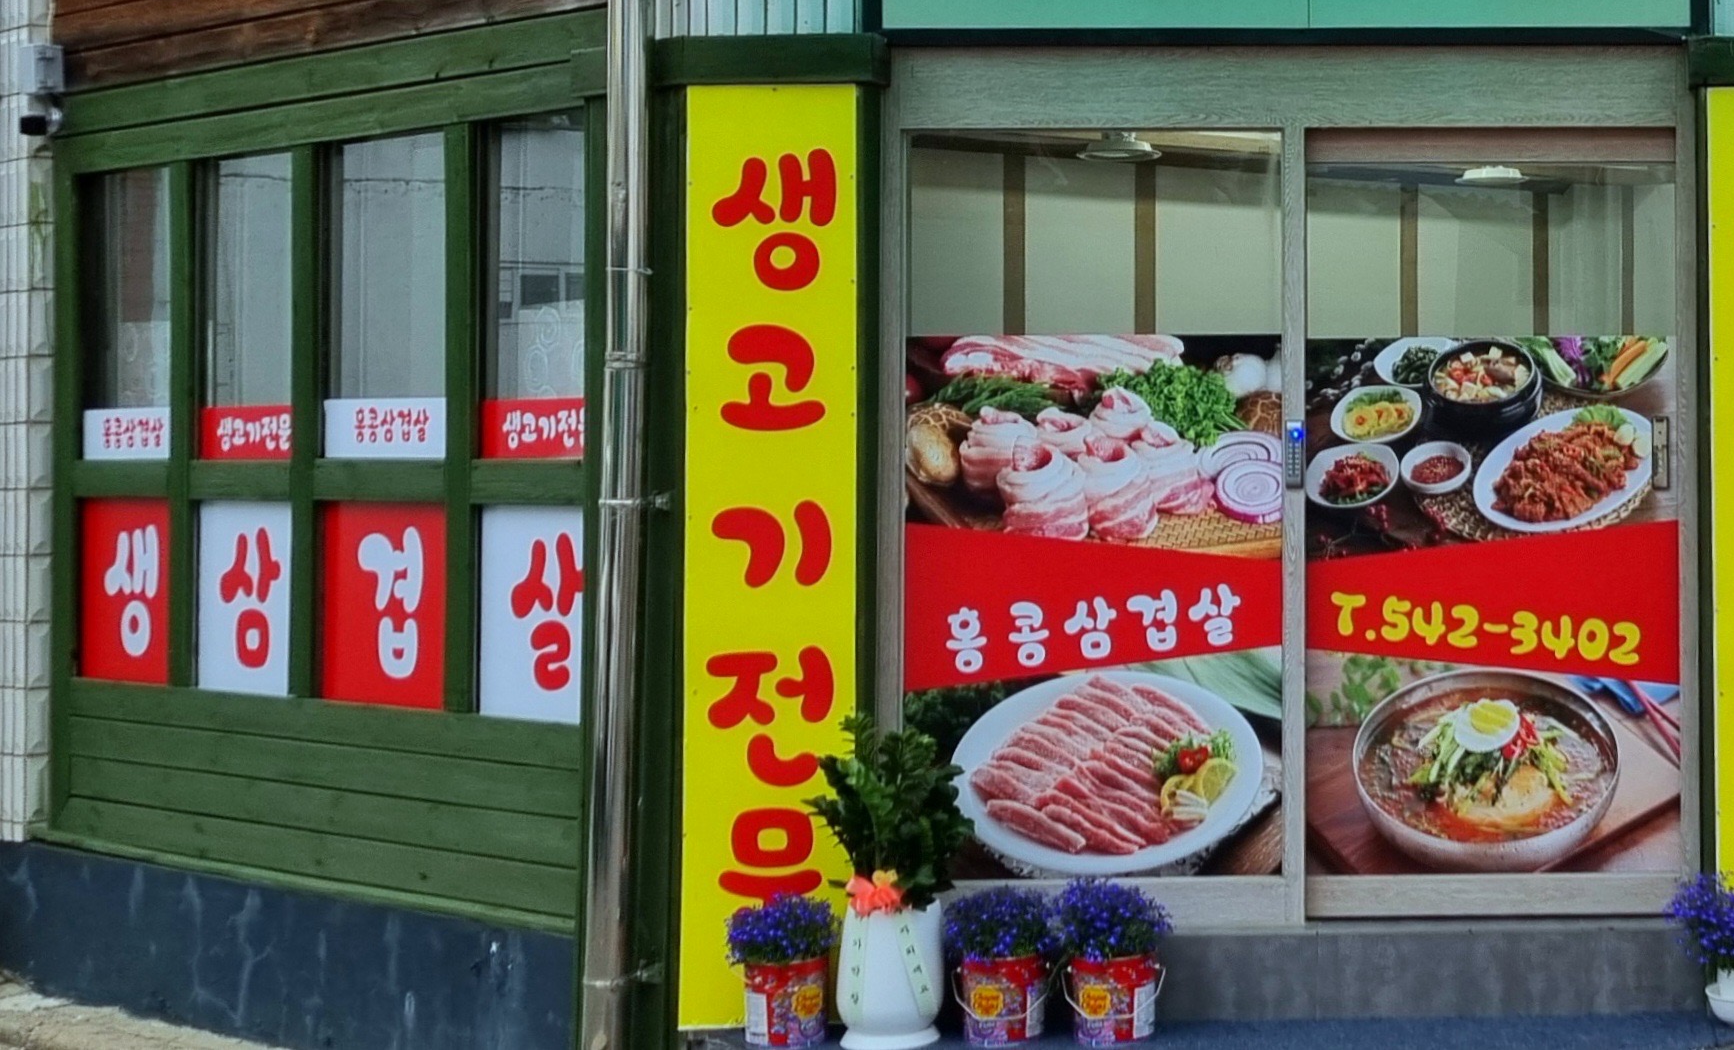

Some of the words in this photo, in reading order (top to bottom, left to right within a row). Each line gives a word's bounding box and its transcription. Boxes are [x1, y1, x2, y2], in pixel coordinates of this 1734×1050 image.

[102, 416, 164, 449] 홍콩삼겹살
[217, 412, 293, 452] 생고기전문
[354, 406, 430, 444] 홍콩삼겹살
[503, 406, 585, 450] 생고기전
[104, 522, 161, 658] 생
[219, 525, 281, 671] 삼
[357, 525, 425, 679] 겹
[946, 583, 1242, 674] 홍콩삼겹살
[1330, 591, 1642, 666] T.542-3402
